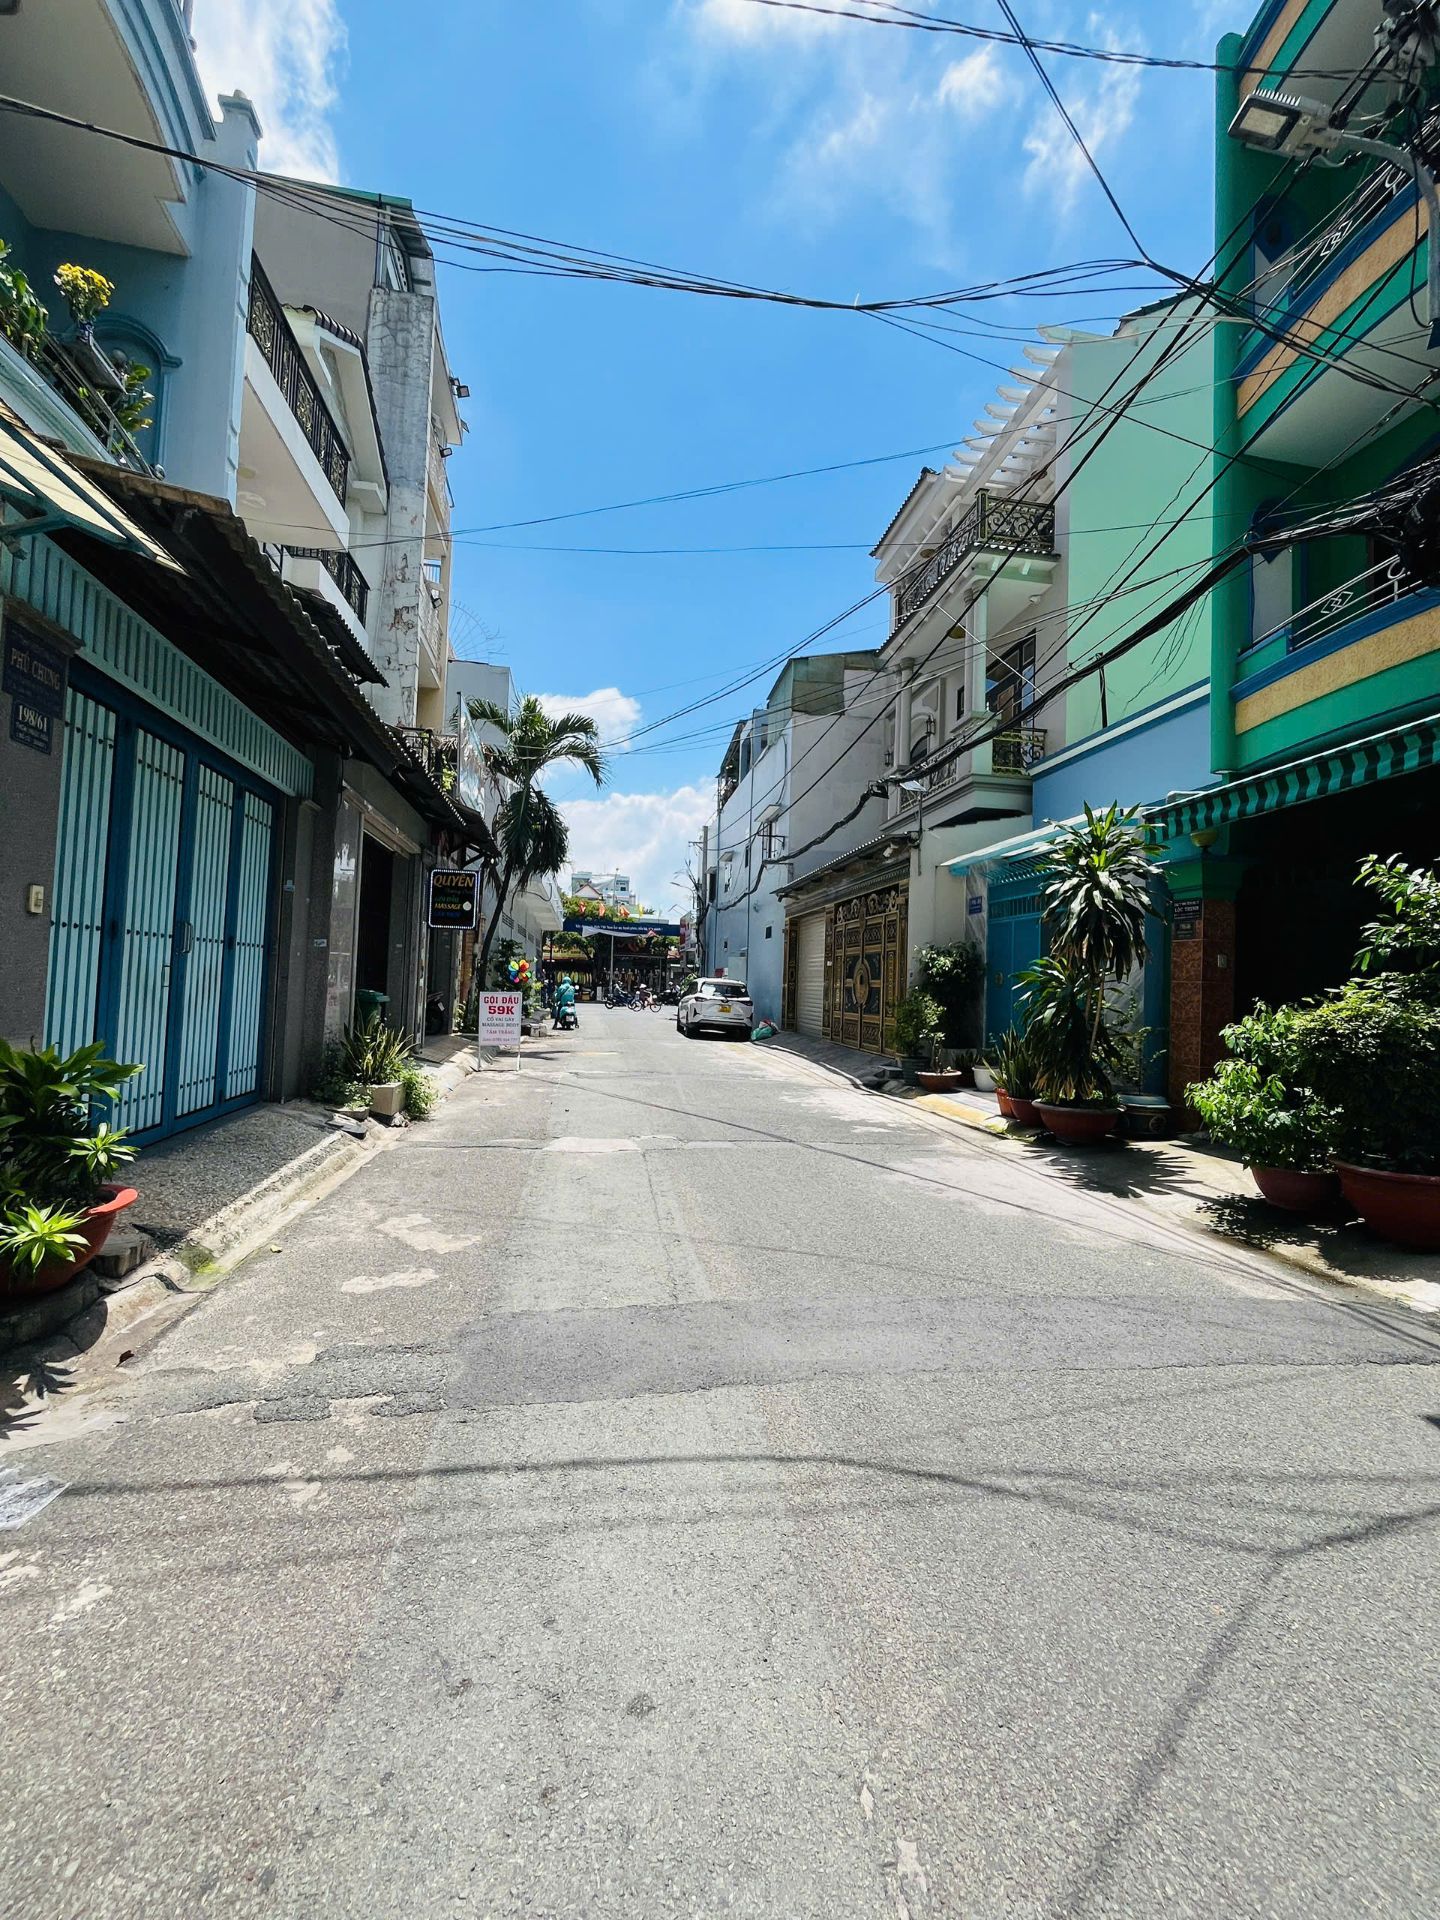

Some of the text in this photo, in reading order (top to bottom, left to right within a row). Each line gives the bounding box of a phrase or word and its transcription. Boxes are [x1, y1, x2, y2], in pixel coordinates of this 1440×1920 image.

[32, 660, 60, 690] CHUNG
[18, 704, 47, 733] 198/61
[434, 902, 462, 910] MASSAGE
[488, 1005, 515, 1015] 59K
